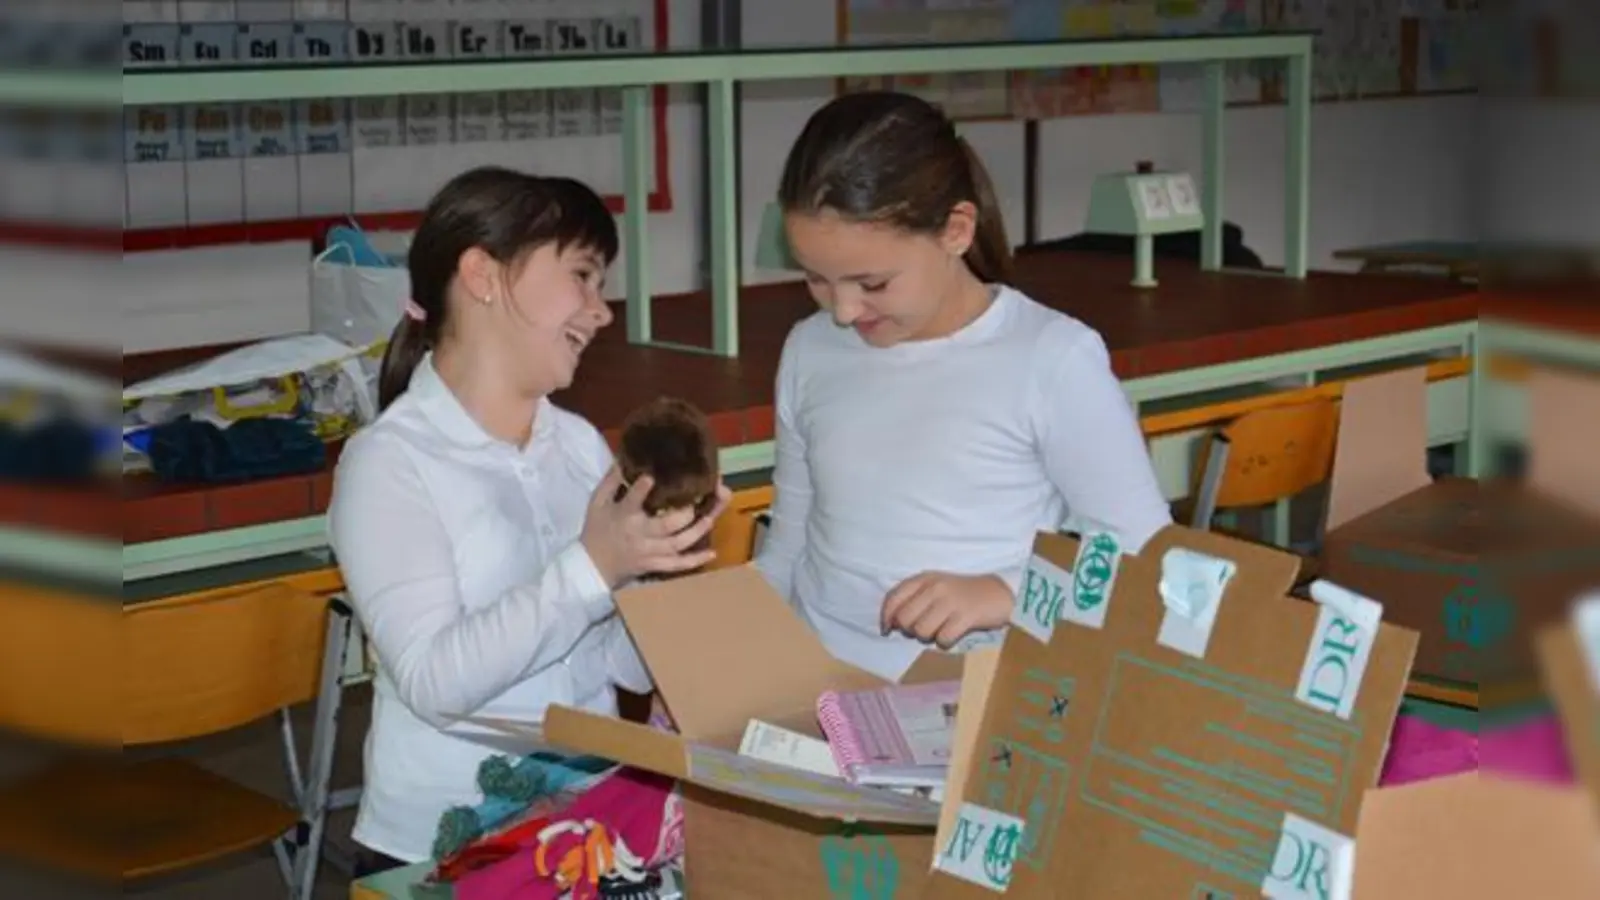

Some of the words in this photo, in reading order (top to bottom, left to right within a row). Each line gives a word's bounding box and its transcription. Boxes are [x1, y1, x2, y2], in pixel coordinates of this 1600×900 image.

[129, 41, 165, 62] Sm
[306, 38, 331, 57] Tb
[459, 26, 487, 53] Er
[510, 25, 542, 51] Tm
